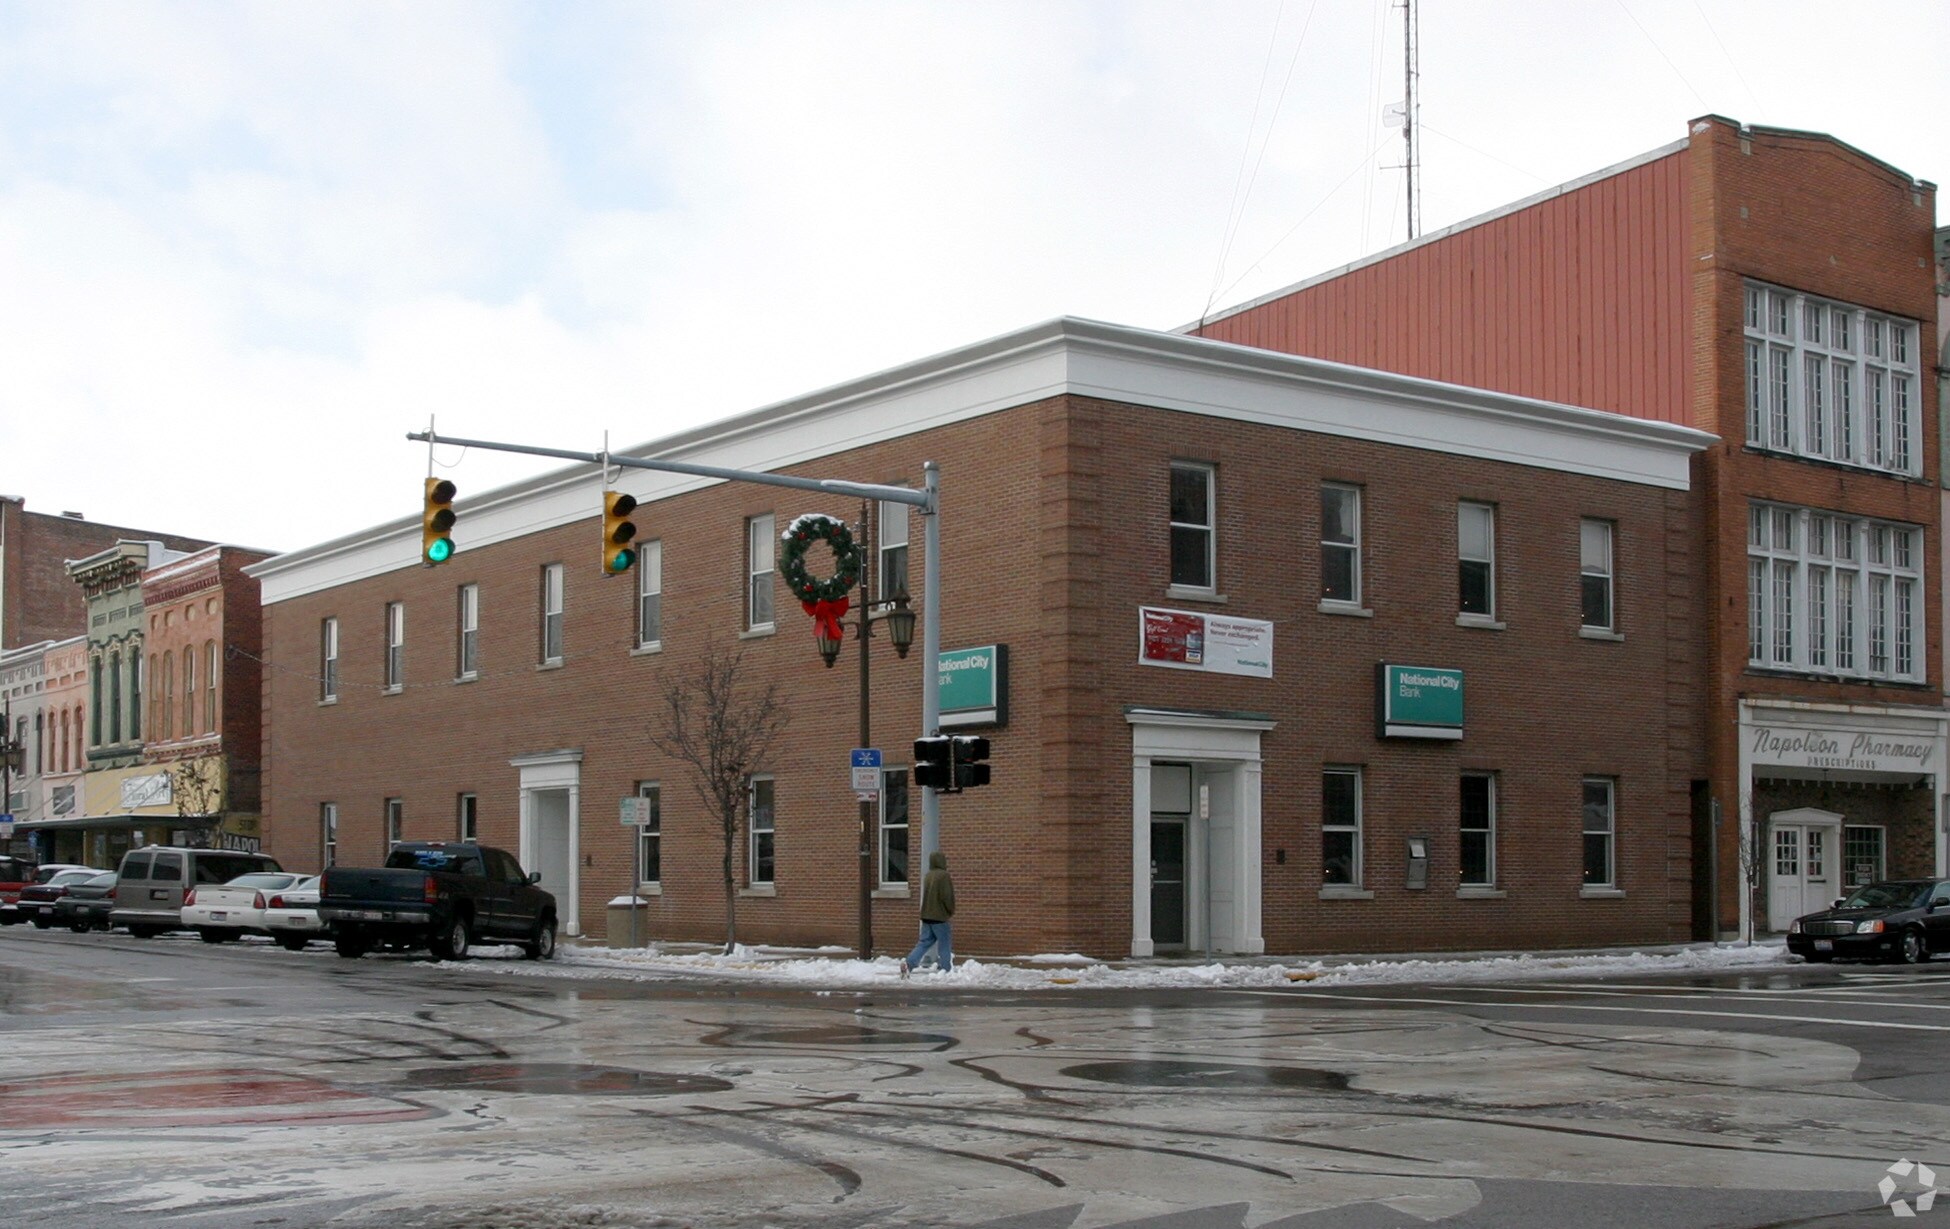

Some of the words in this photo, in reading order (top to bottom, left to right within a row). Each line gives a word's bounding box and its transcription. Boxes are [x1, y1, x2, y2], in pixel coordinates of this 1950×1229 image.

[938, 673, 952, 685] ank
[1400, 685, 1420, 698] Bank
[1849, 732, 1933, 766] Pharmacy
